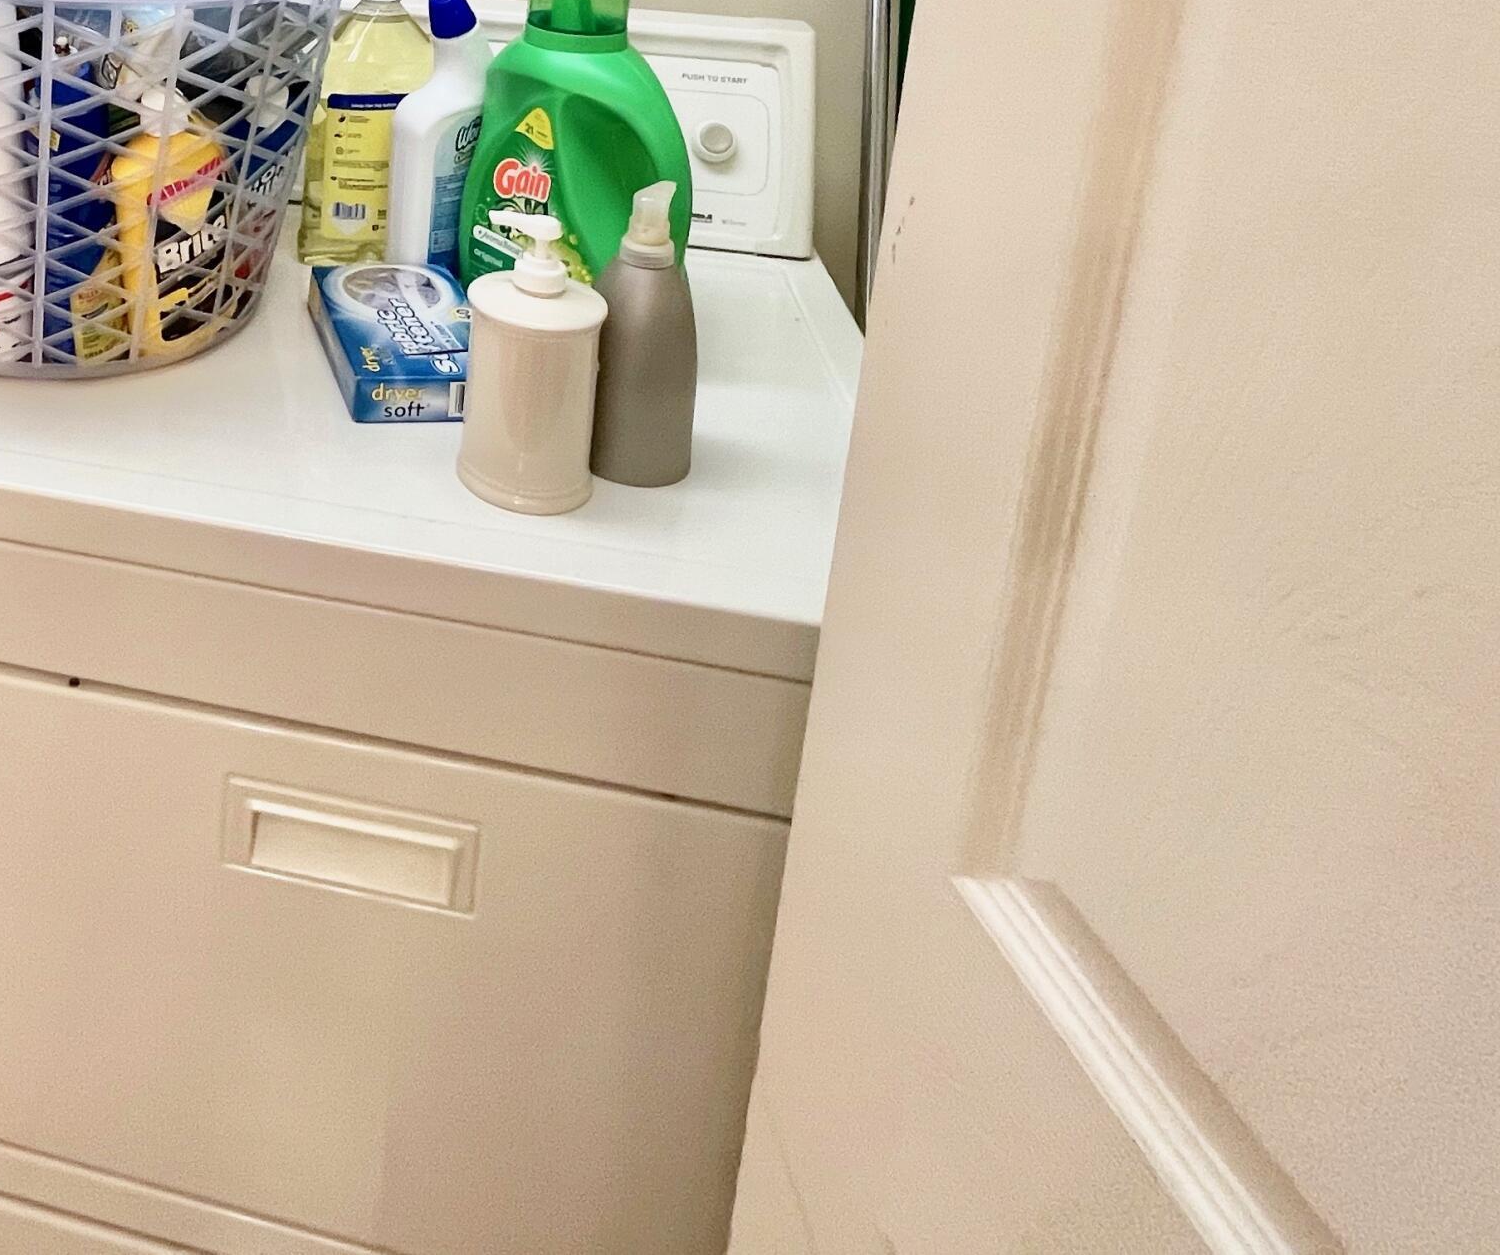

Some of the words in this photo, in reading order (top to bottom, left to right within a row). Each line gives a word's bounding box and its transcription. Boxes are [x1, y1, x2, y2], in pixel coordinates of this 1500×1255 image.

[681, 72, 705, 82] PUSH
[707, 74, 719, 83] TO
[720, 76, 748, 85] START
[494, 158, 552, 203] Gain
[371, 382, 427, 403] dryer
[384, 401, 426, 418] soft
